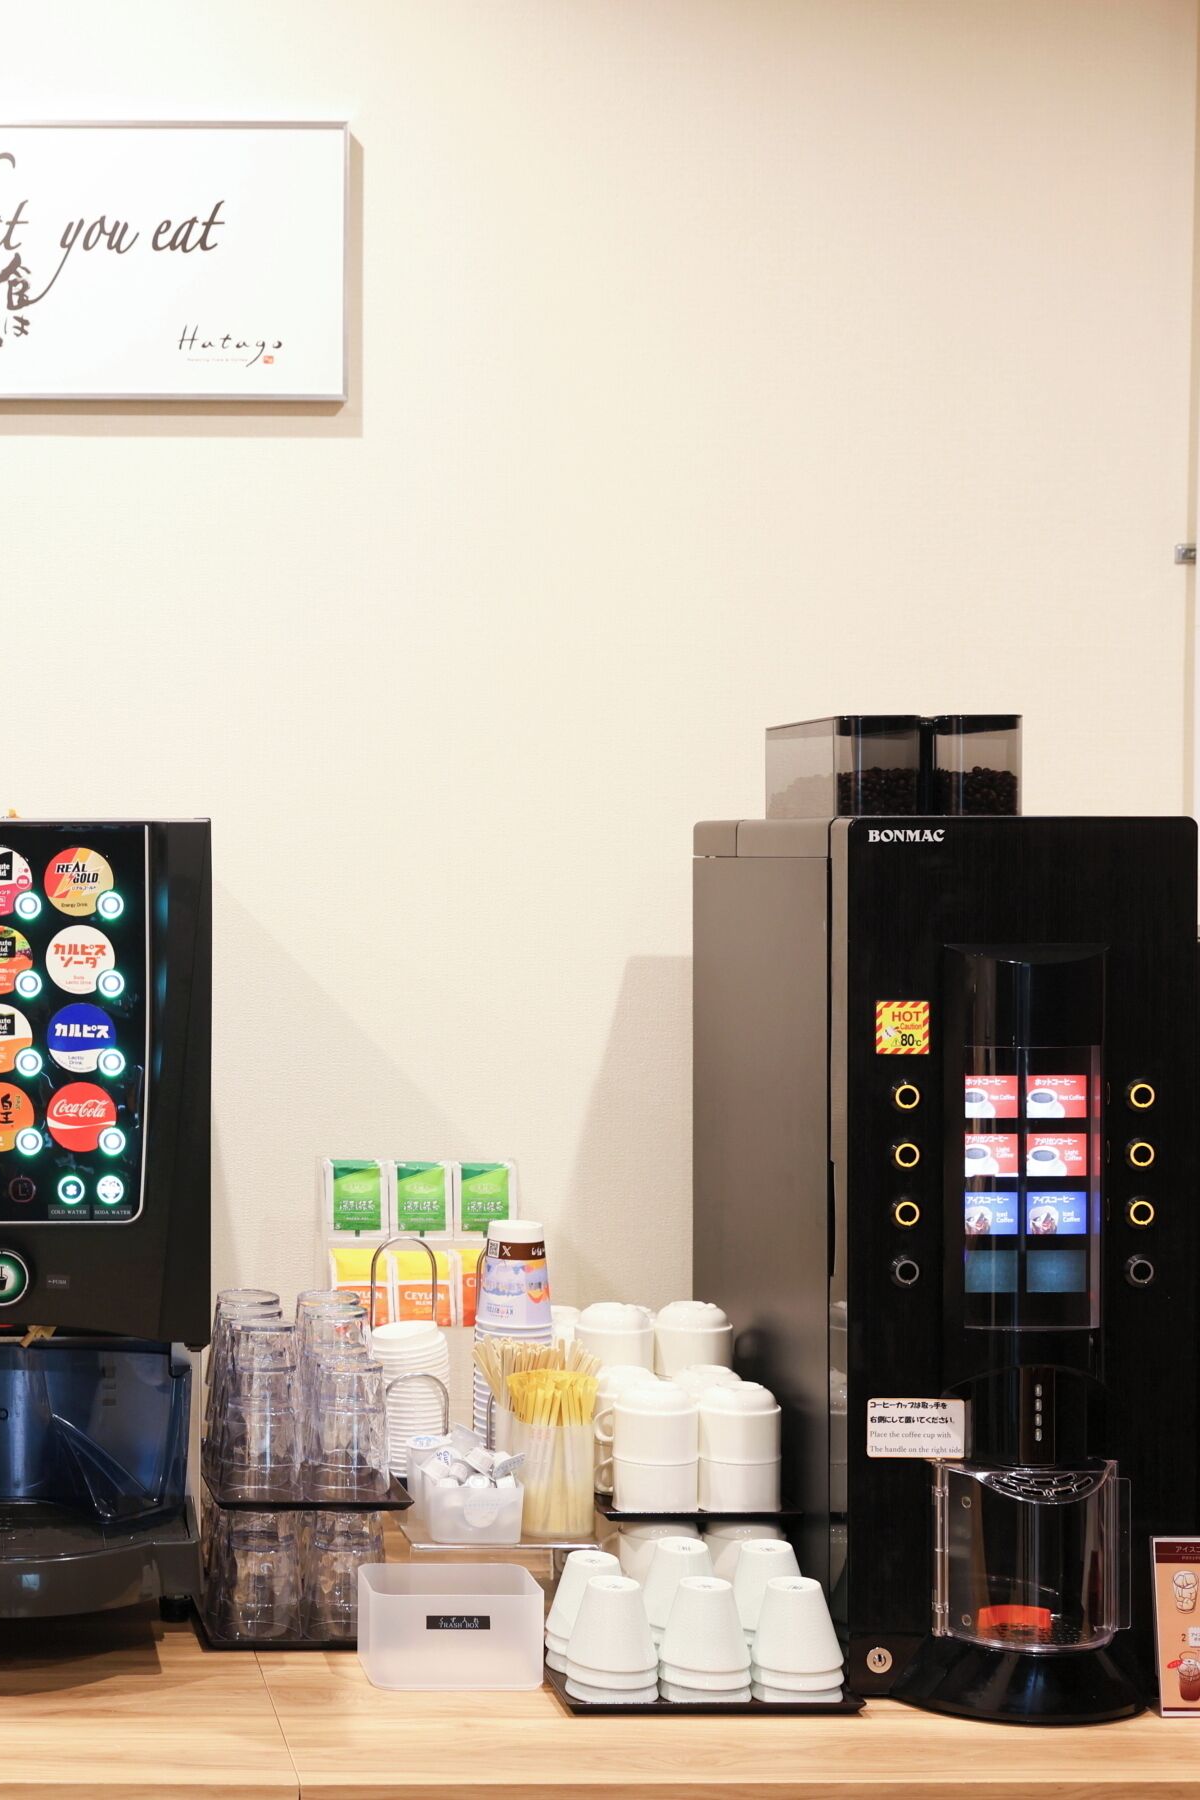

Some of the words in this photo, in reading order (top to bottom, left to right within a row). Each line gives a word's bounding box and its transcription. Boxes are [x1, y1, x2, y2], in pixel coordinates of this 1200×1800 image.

[151, 200, 227, 254] eat
[868, 829, 945, 843] BONMAC
[56, 861, 88, 873] REAL
[73, 872, 99, 884] GOLD
[54, 943, 107, 956] カルピス
[60, 956, 100, 969] ソーダ
[892, 1011, 922, 1023] HOT
[55, 1023, 110, 1039] カルピス
[900, 1022, 922, 1030] Caution
[1035, 1078, 1076, 1086] ホットコーヒー
[53, 1098, 109, 1118] Coca-Cola
[18, 1184, 27, 1197] L
[966, 1196, 1009, 1204] アイスコーヒー
[1032, 1195, 1075, 1204] アイスコーヒー
[869, 1401, 948, 1410] コーヒーカップは取っ手を
[922, 1432, 936, 1440] cup
[870, 1445, 883, 1453] The
[884, 1445, 907, 1453] handle
[931, 1446, 947, 1455] right
[1181, 1633, 1187, 1642] 2
